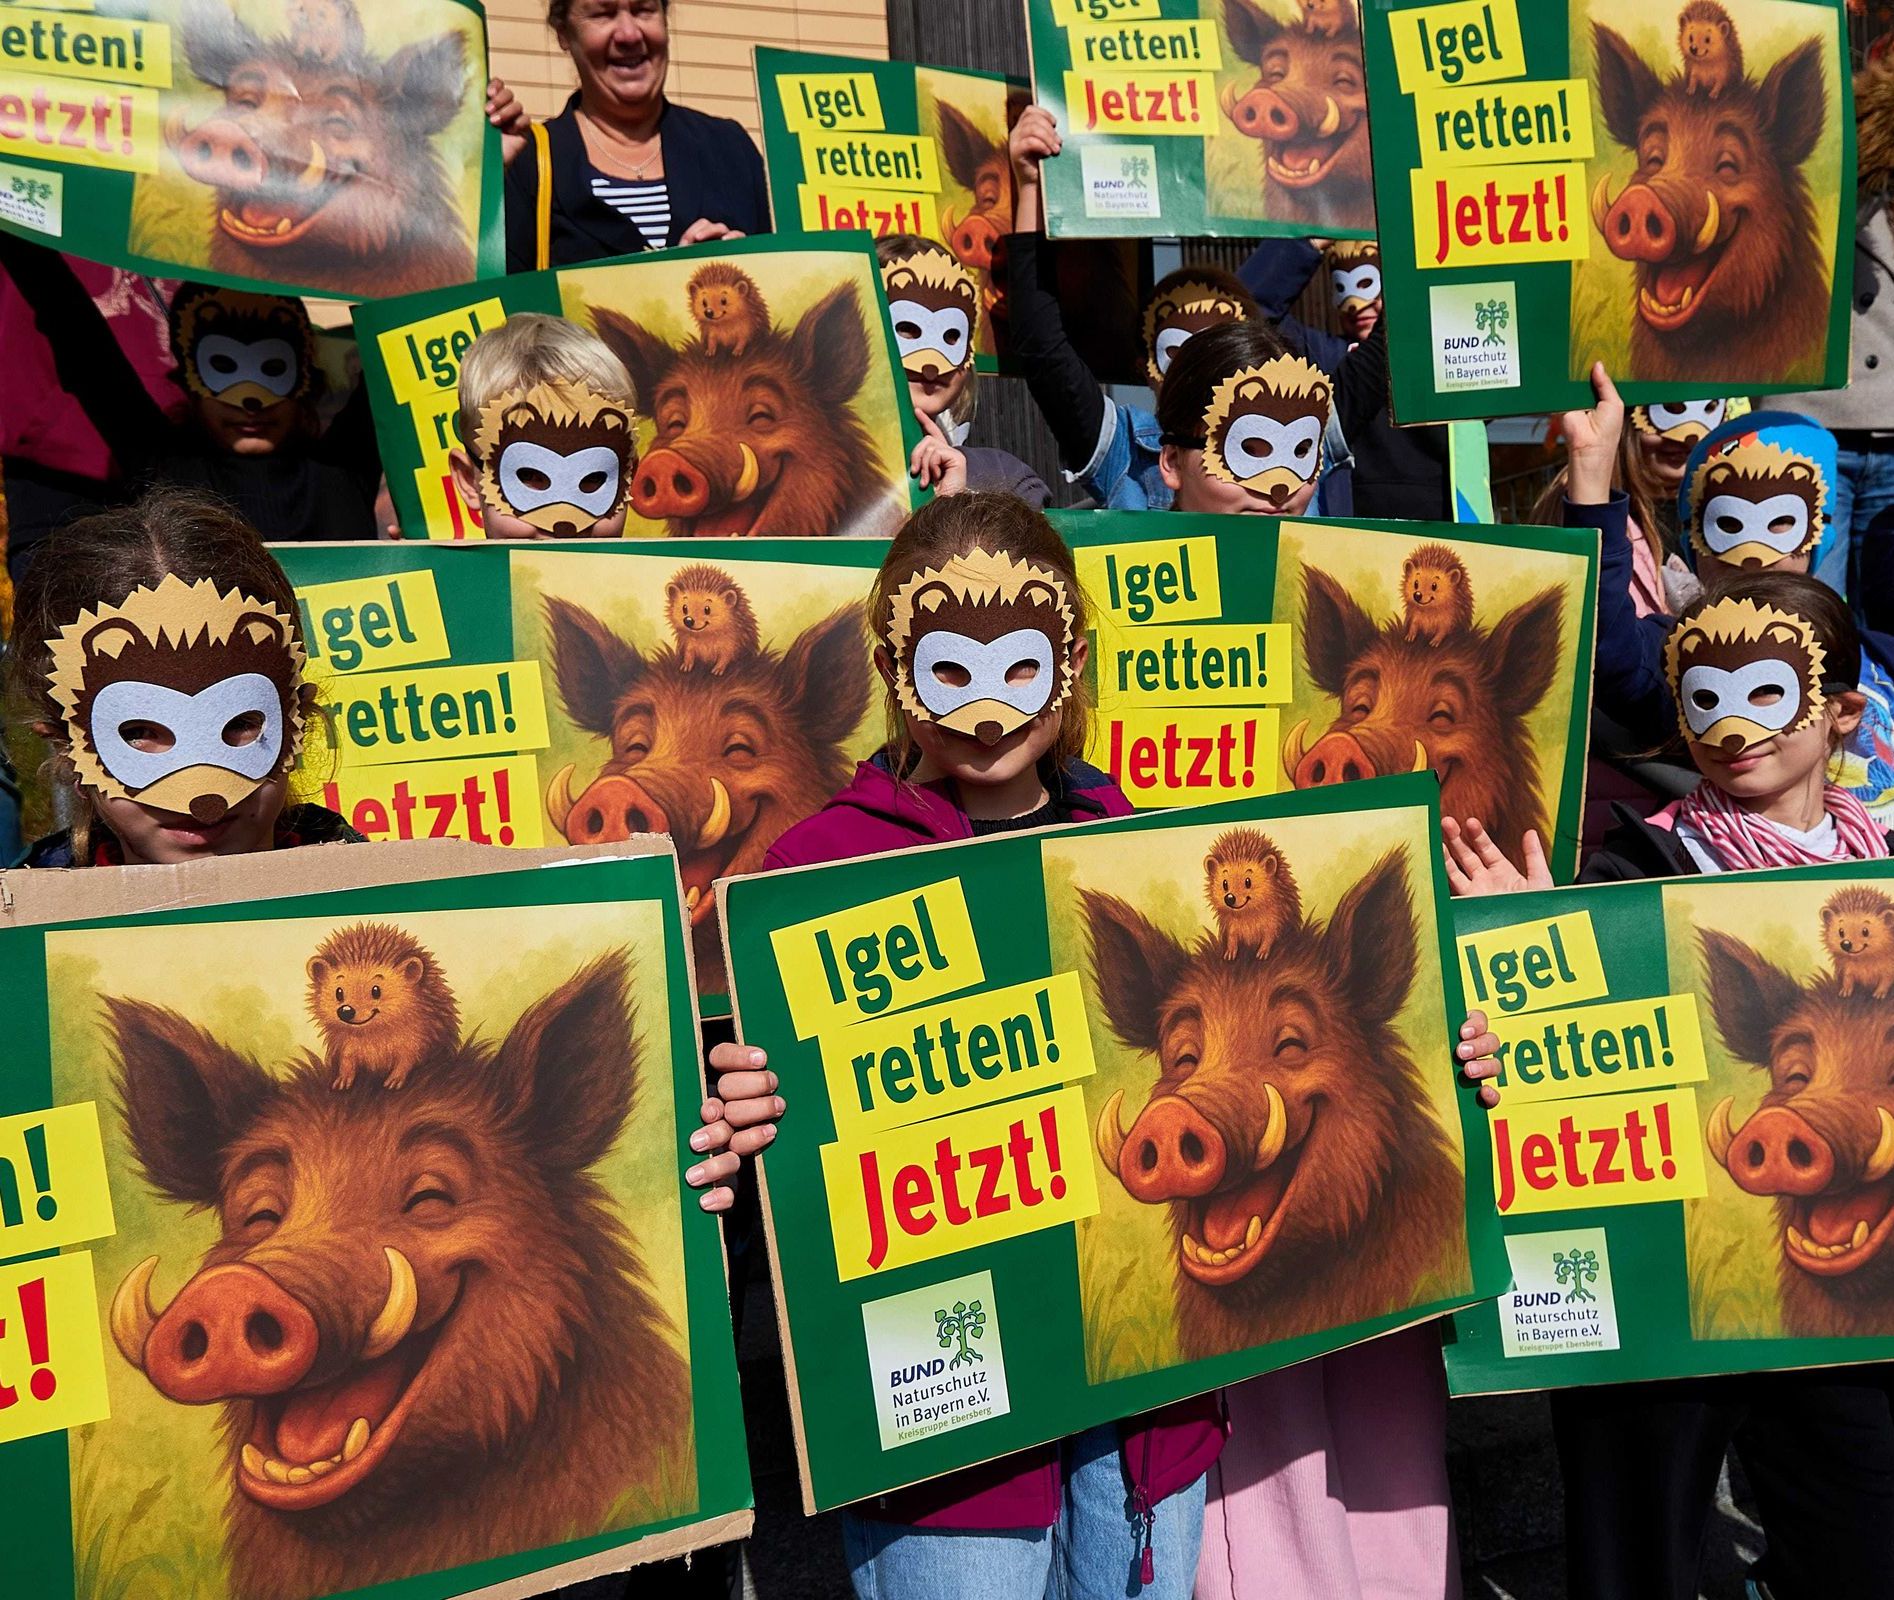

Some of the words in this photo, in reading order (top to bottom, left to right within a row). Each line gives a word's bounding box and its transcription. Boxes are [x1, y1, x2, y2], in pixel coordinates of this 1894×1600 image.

[1085, 27, 1200, 61] retten!
[1417, 4, 1503, 83] Igel
[799, 78, 866, 128] Igel
[1085, 79, 1200, 130] Jetzt!
[1435, 90, 1571, 152] retten!
[816, 141, 922, 180] retten!
[1094, 180, 1125, 189] BUND
[1435, 174, 1569, 264] Jetzt!
[1444, 337, 1479, 349] BUND
[1444, 351, 1507, 365] Naturschutz
[1445, 368, 1454, 379] in
[1456, 366, 1491, 380] Bayern
[1493, 364, 1508, 376] e.V.
[1105, 543, 1197, 622] Igel
[296, 580, 417, 671] Igel
[1117, 632, 1268, 692] retten!
[323, 671, 517, 750] retten!
[814, 894, 949, 1014] Igel
[1465, 922, 1577, 1012] Igel
[850, 988, 1060, 1113] retten!
[1496, 1005, 1674, 1087] retten!
[1493, 1102, 1677, 1213] Jetzt!
[858, 1106, 1067, 1270] Jetzt!
[1513, 1292, 1561, 1308] BUND
[1515, 1309, 1599, 1325] Naturschutz
[1517, 1329, 1529, 1342] in
[1533, 1327, 1578, 1342] Bayern
[1581, 1324, 1602, 1337] e.V.
[890, 1358, 945, 1388] BUND
[893, 1371, 987, 1408] Naturschutz
[895, 1413, 910, 1428] in
[913, 1397, 964, 1424] Bayern
[968, 1388, 991, 1406] e.V.
[898, 1419, 948, 1440] Kreisgruppe
[951, 1406, 992, 1424] Ebersberg
